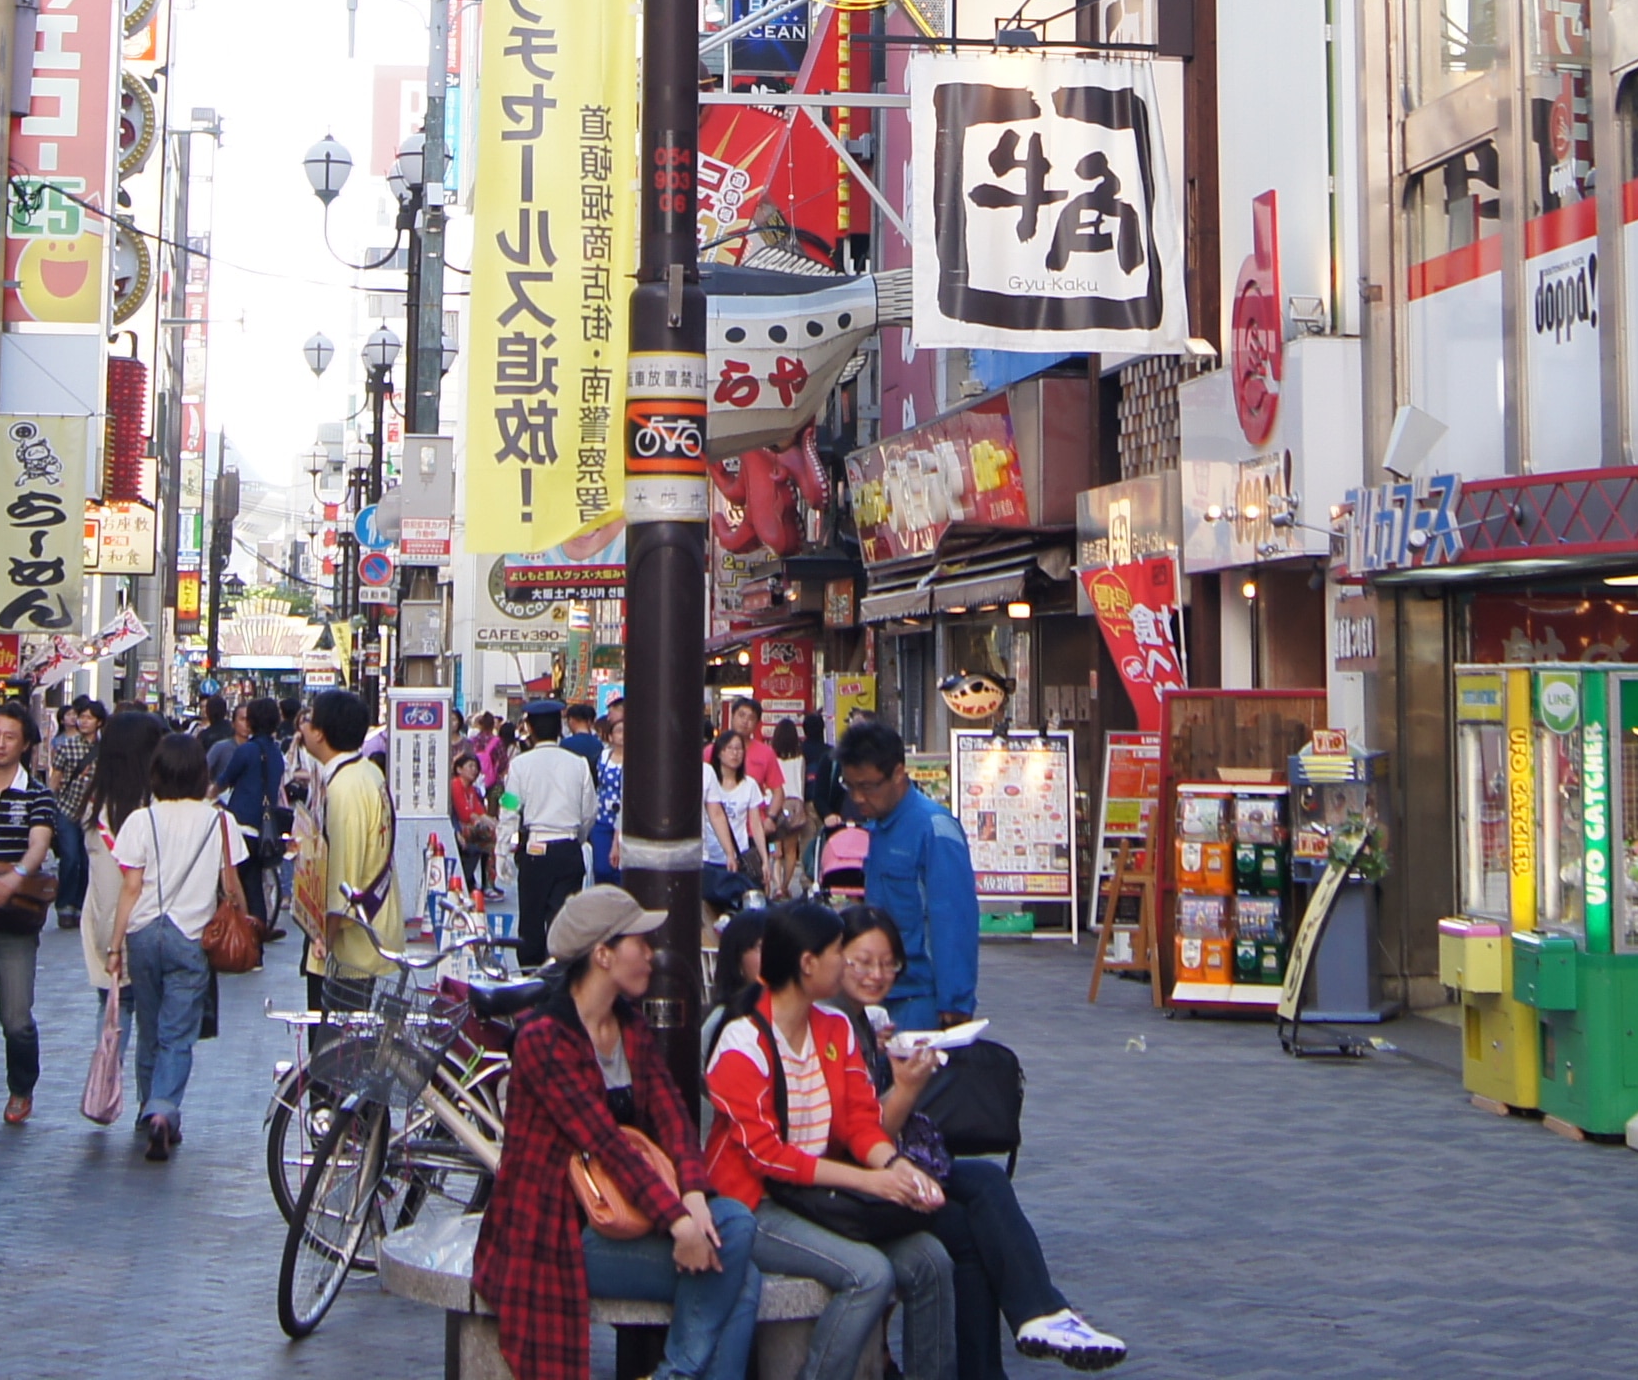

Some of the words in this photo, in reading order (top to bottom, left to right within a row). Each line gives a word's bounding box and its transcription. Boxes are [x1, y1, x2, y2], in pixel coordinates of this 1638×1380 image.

[654, 147, 691, 165] 054
[654, 172, 691, 190] 903
[659, 194, 687, 212] 06
[966, 127, 1146, 276] 牛角
[1007, 275, 1100, 293] Gyu-Kaku
[713, 355, 809, 408] らや
[360, 589, 389, 600] 自動車
[477, 629, 521, 640] CAFE
[1547, 694, 1571, 705] LINE
[1510, 728, 1527, 774] UFO
[1584, 721, 1606, 841] CATCHER
[1586, 849, 1607, 905] UFO
